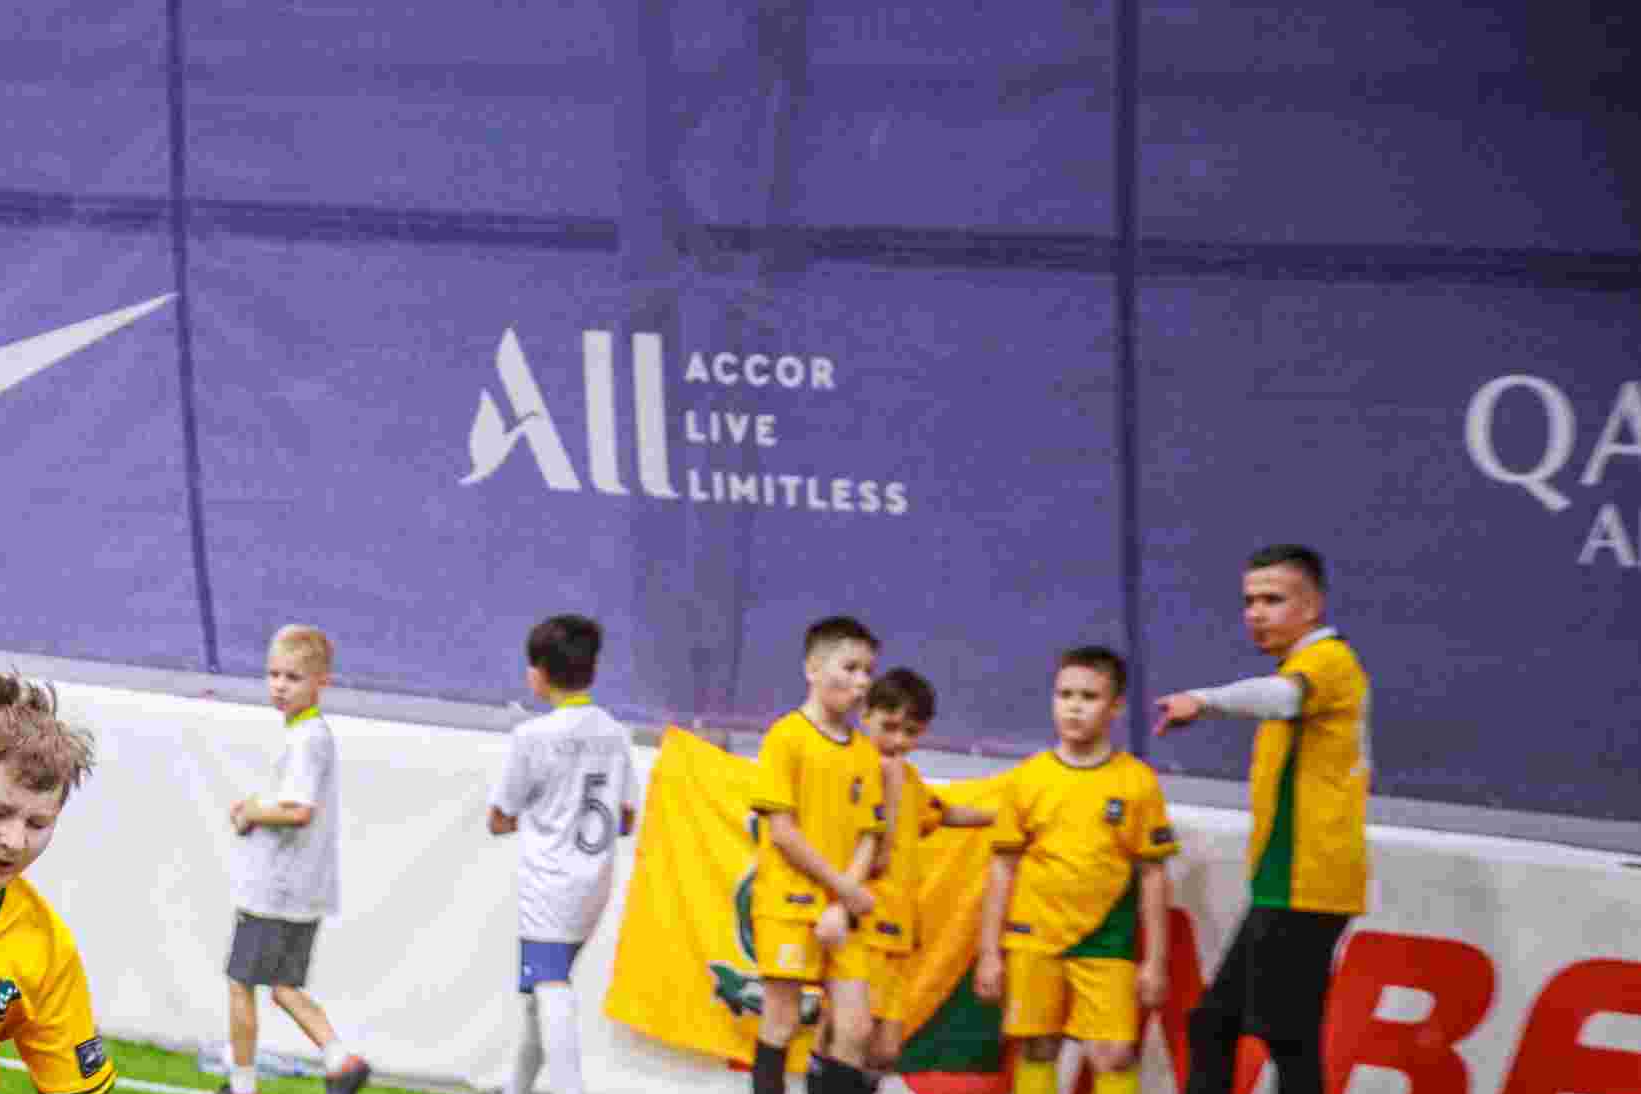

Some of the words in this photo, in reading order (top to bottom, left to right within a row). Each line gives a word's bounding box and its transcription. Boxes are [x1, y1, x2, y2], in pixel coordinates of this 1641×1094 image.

[684, 351, 836, 390] ACCOR
[684, 410, 778, 447] LIVE
[686, 468, 910, 515] LIMITLESS
[574, 772, 614, 855] 5
